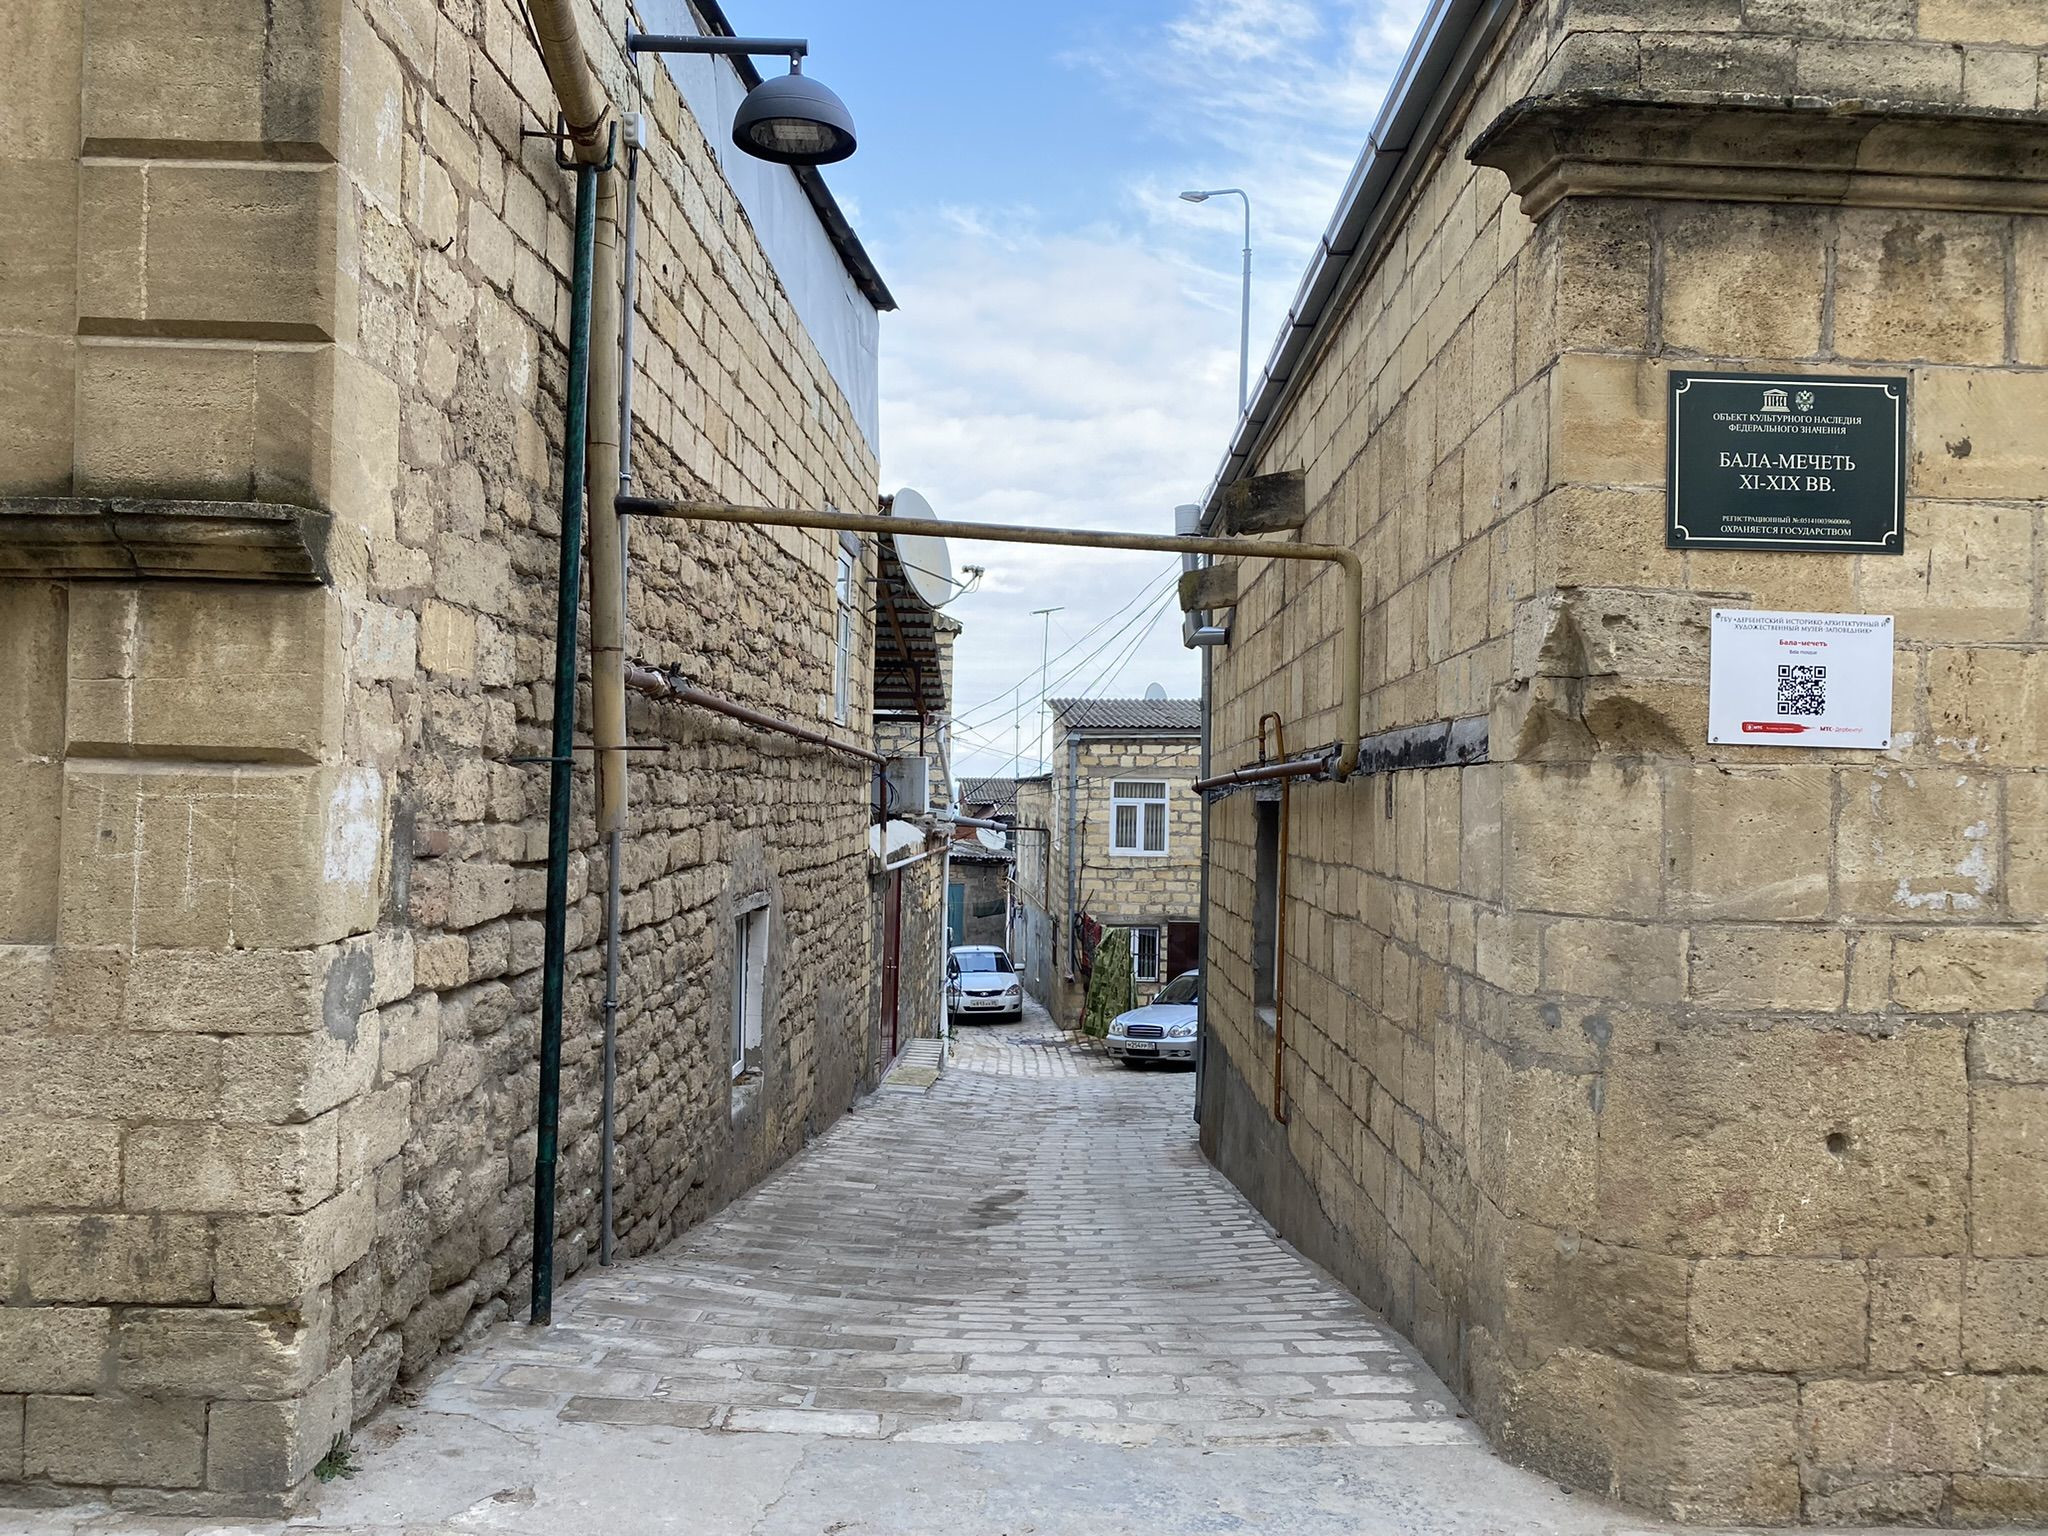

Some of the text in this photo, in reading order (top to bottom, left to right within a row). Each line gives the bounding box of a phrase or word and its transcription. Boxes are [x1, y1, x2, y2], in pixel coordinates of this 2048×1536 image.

[1713, 412, 1862, 425] ОБЪЕКТ КУЛЬТУРНОГО НАСЛЕДИЯ
[1728, 423, 1847, 435] ФЕДЕРАЛЬНОГО ЗНАЧЕНИЯ
[1719, 452, 1856, 471] БАЛА-МЕЧЕТЬ
[1739, 474, 1836, 492] XI-XIX ВВ.
[1722, 515, 1791, 524] РЕГИСТРАЦИОННЫЙ
[1720, 525, 1852, 536] ОХРАНЯЕТСЯ ГОСУДАРСТВОМ
[1734, 623, 1800, 632] ХУДОЖЕСТВЕННЫЙ
[1779, 639, 1828, 647] Бала-мечеть
